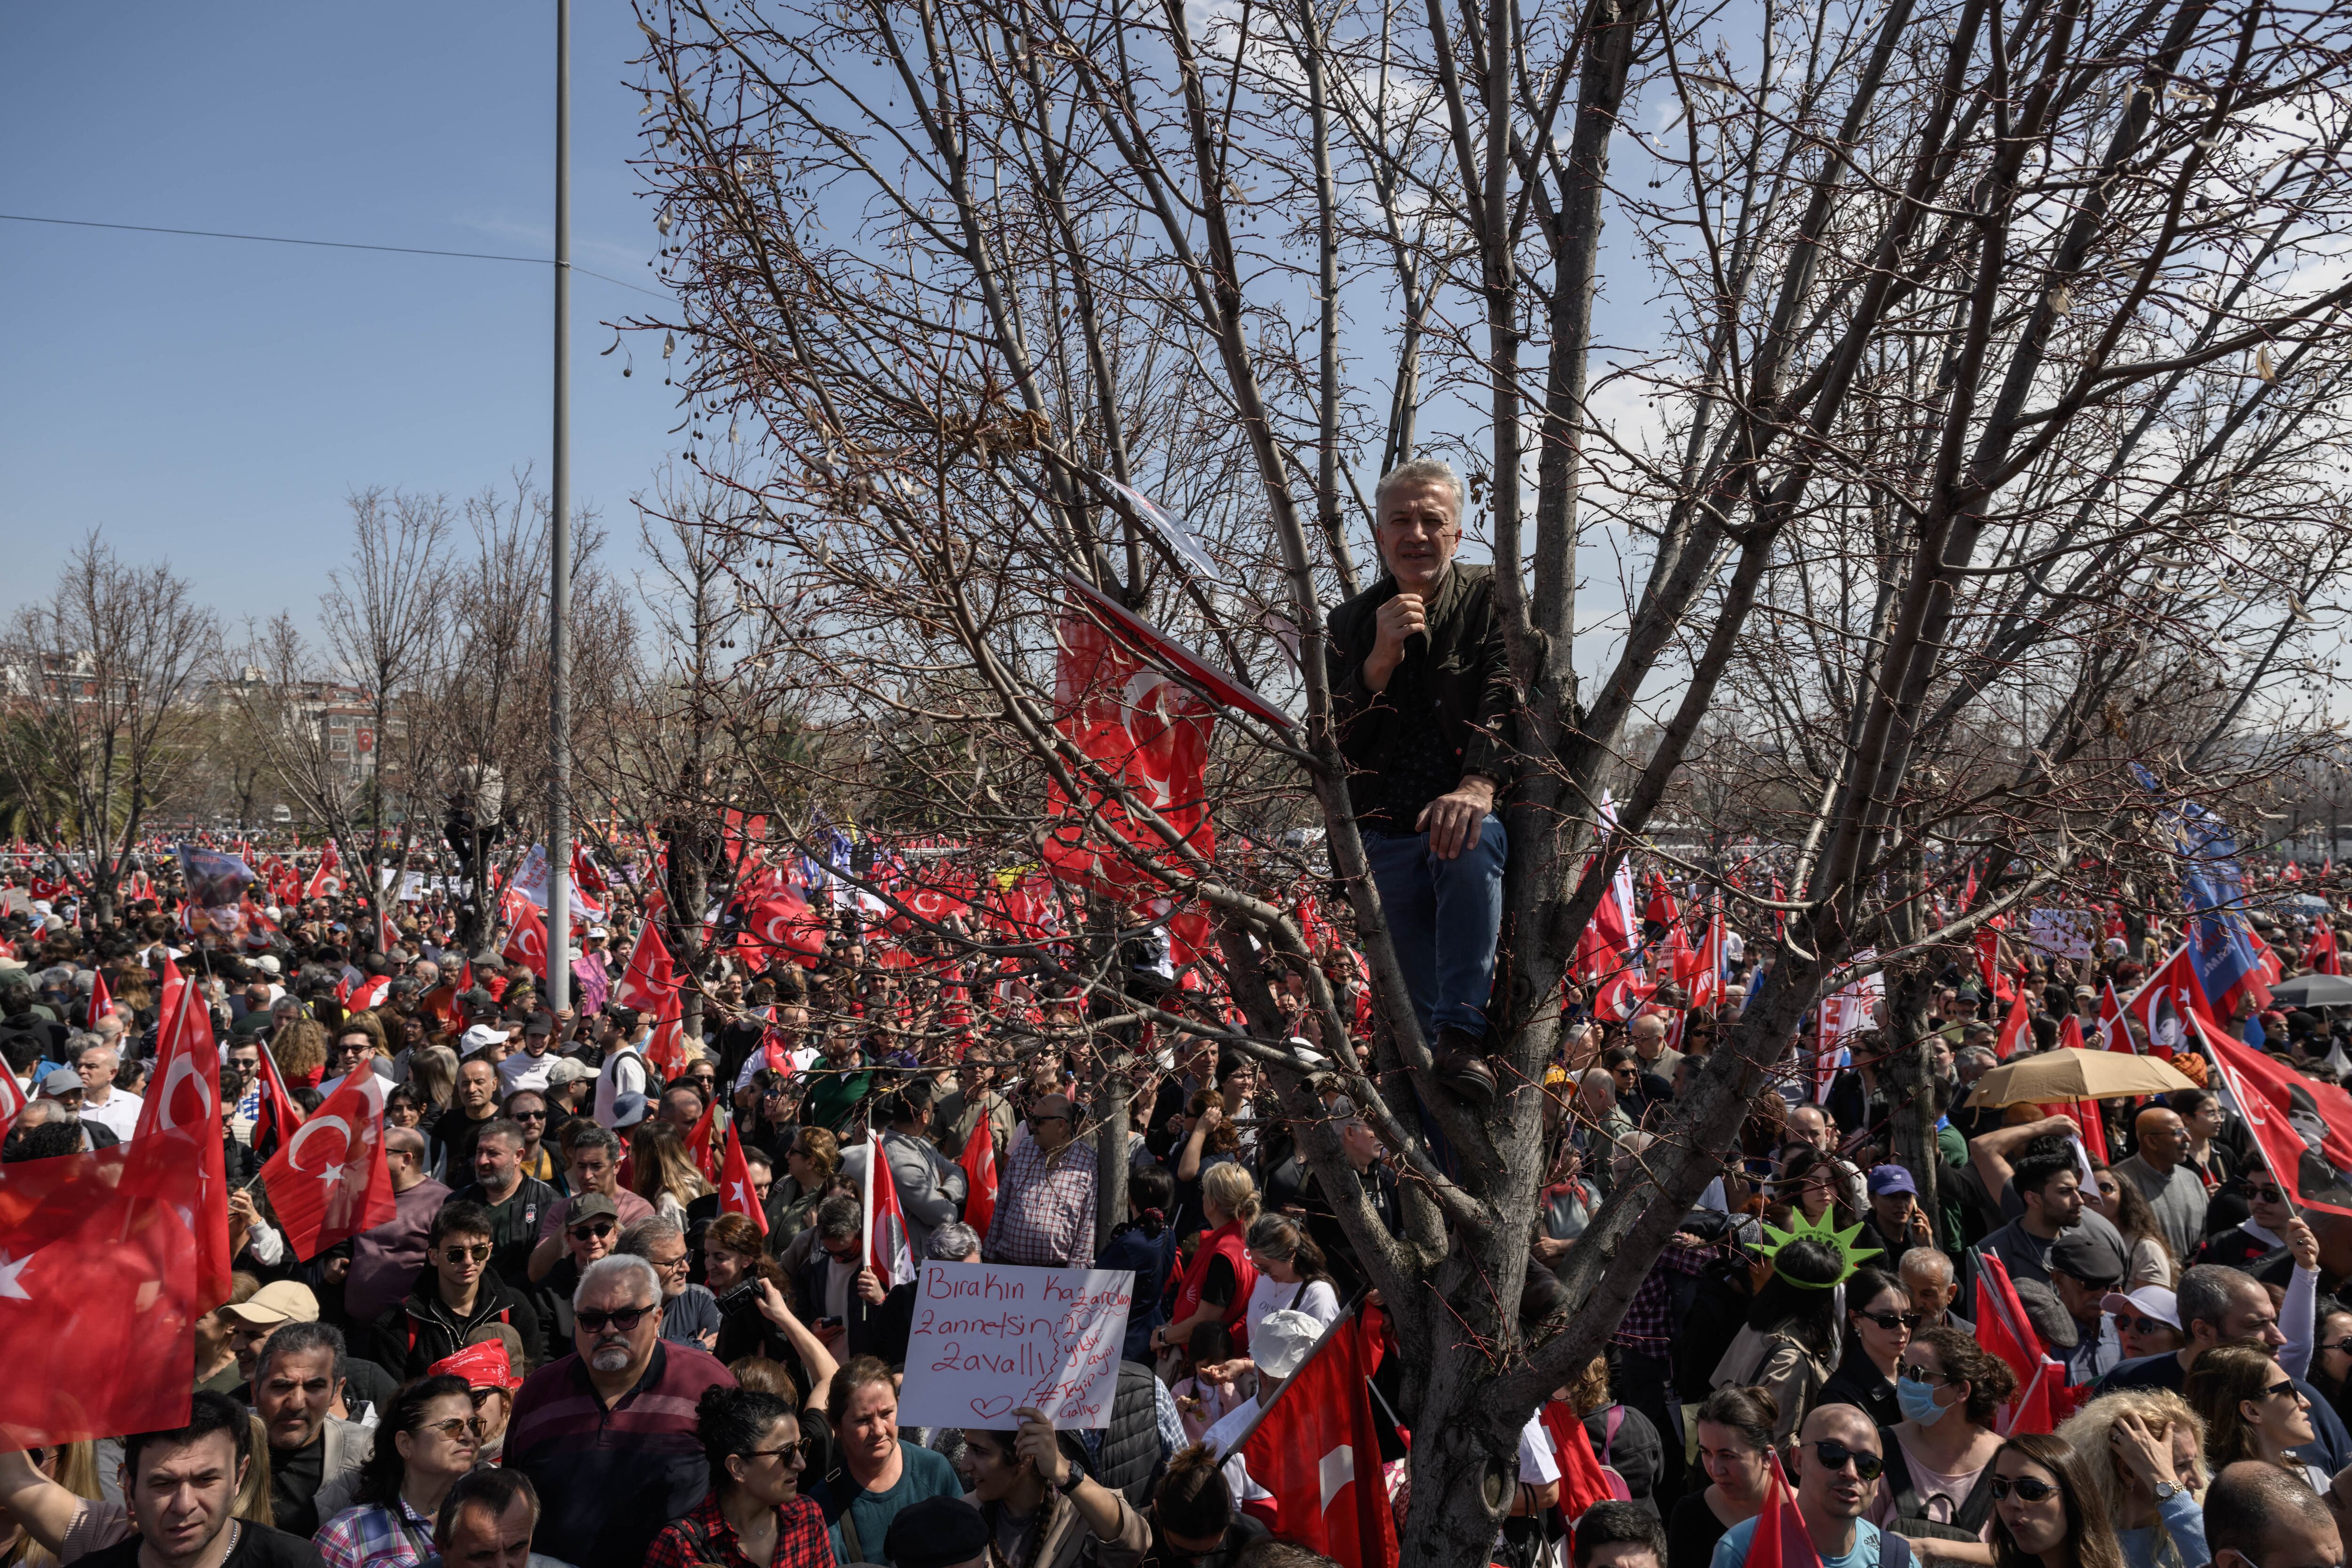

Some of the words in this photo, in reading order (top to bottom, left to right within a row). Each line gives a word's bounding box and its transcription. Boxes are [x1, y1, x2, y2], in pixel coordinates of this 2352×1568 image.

[1824, 1233, 1841, 1244] LIBERTY
[914, 1309, 1052, 1339] Zannetsin
[1063, 1312, 1092, 1338] 20
[931, 1341, 1045, 1377] Zavallı
[1088, 1345, 1114, 1376] aynı
